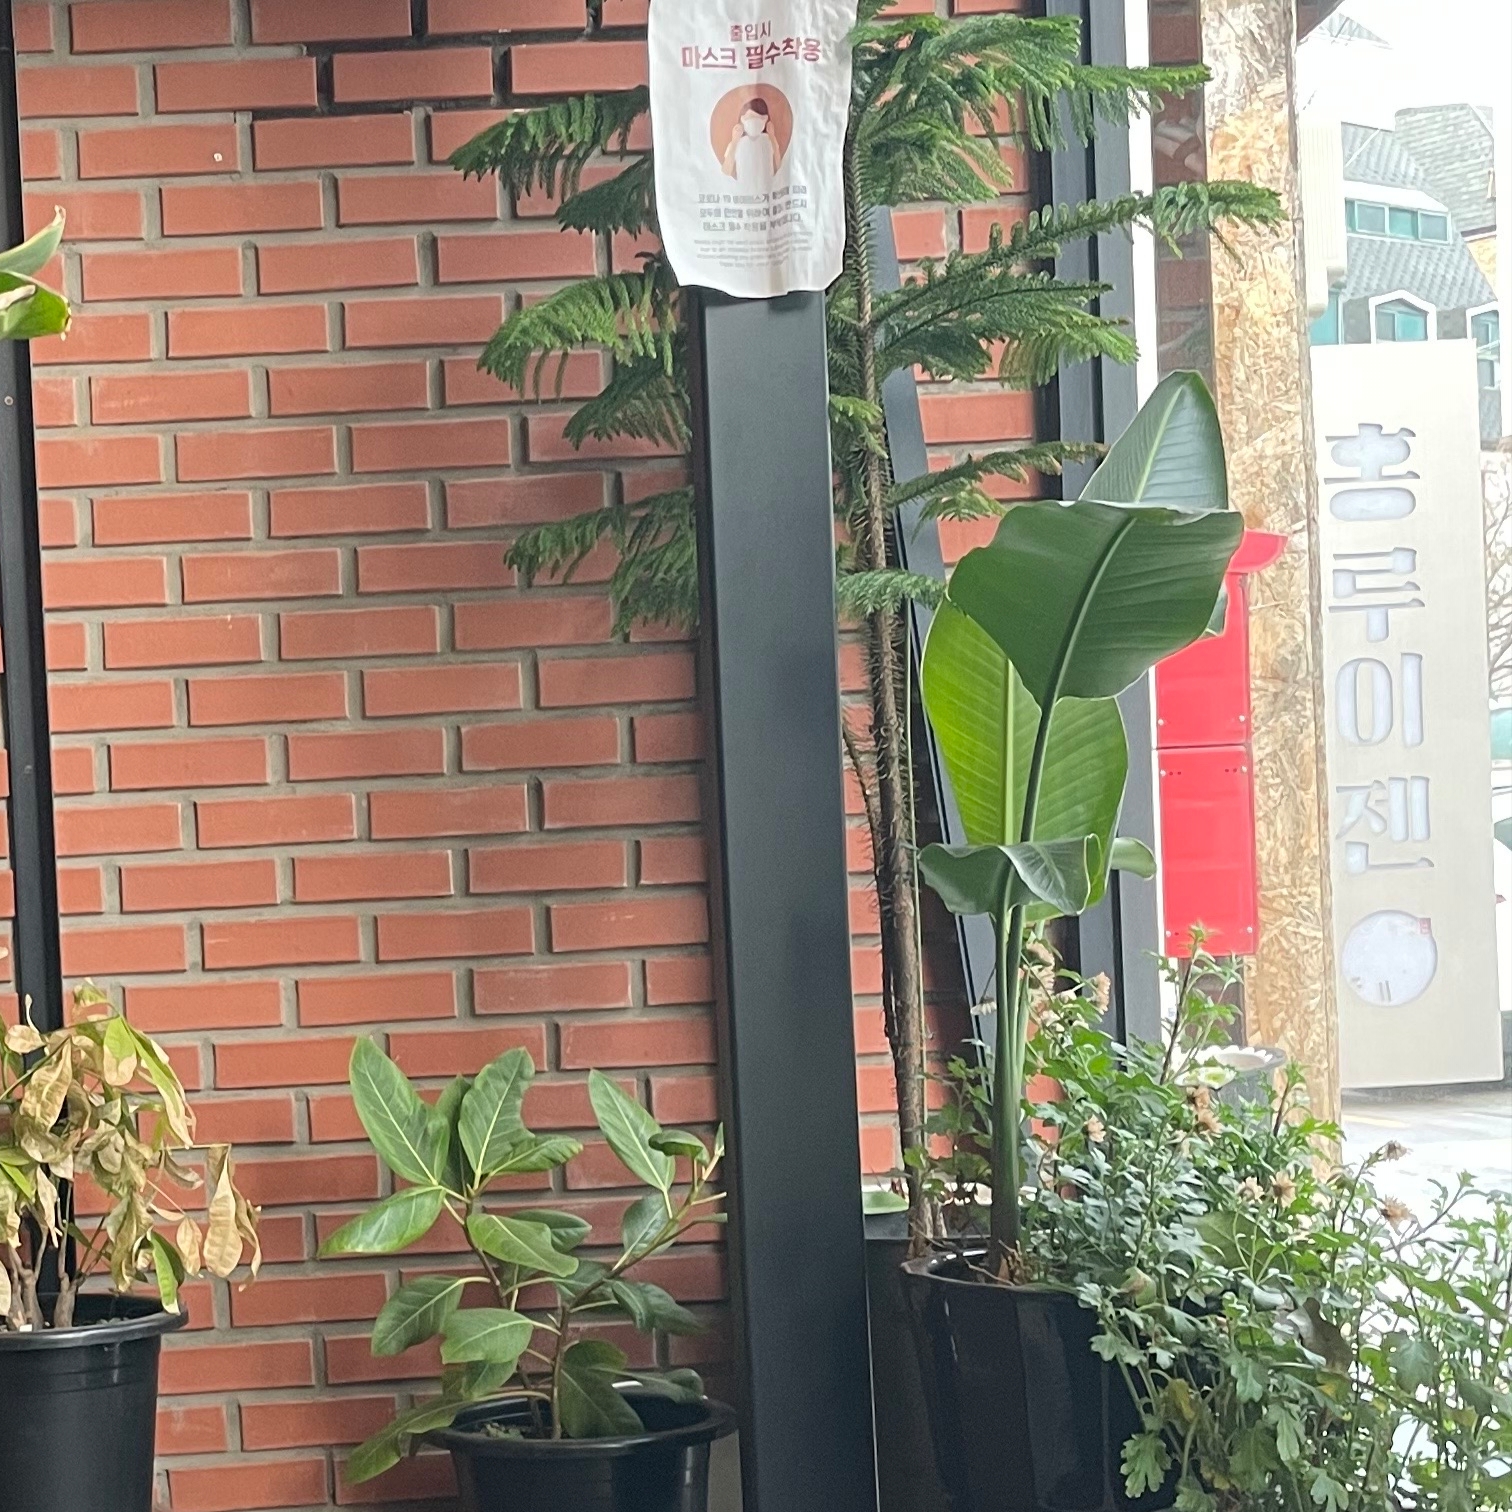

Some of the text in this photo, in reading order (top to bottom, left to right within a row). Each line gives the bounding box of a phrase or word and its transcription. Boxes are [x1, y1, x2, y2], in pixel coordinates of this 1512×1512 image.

[682, 37, 821, 69] 마스크 필수착용
[1324, 423, 1435, 874] 홍루이젠
